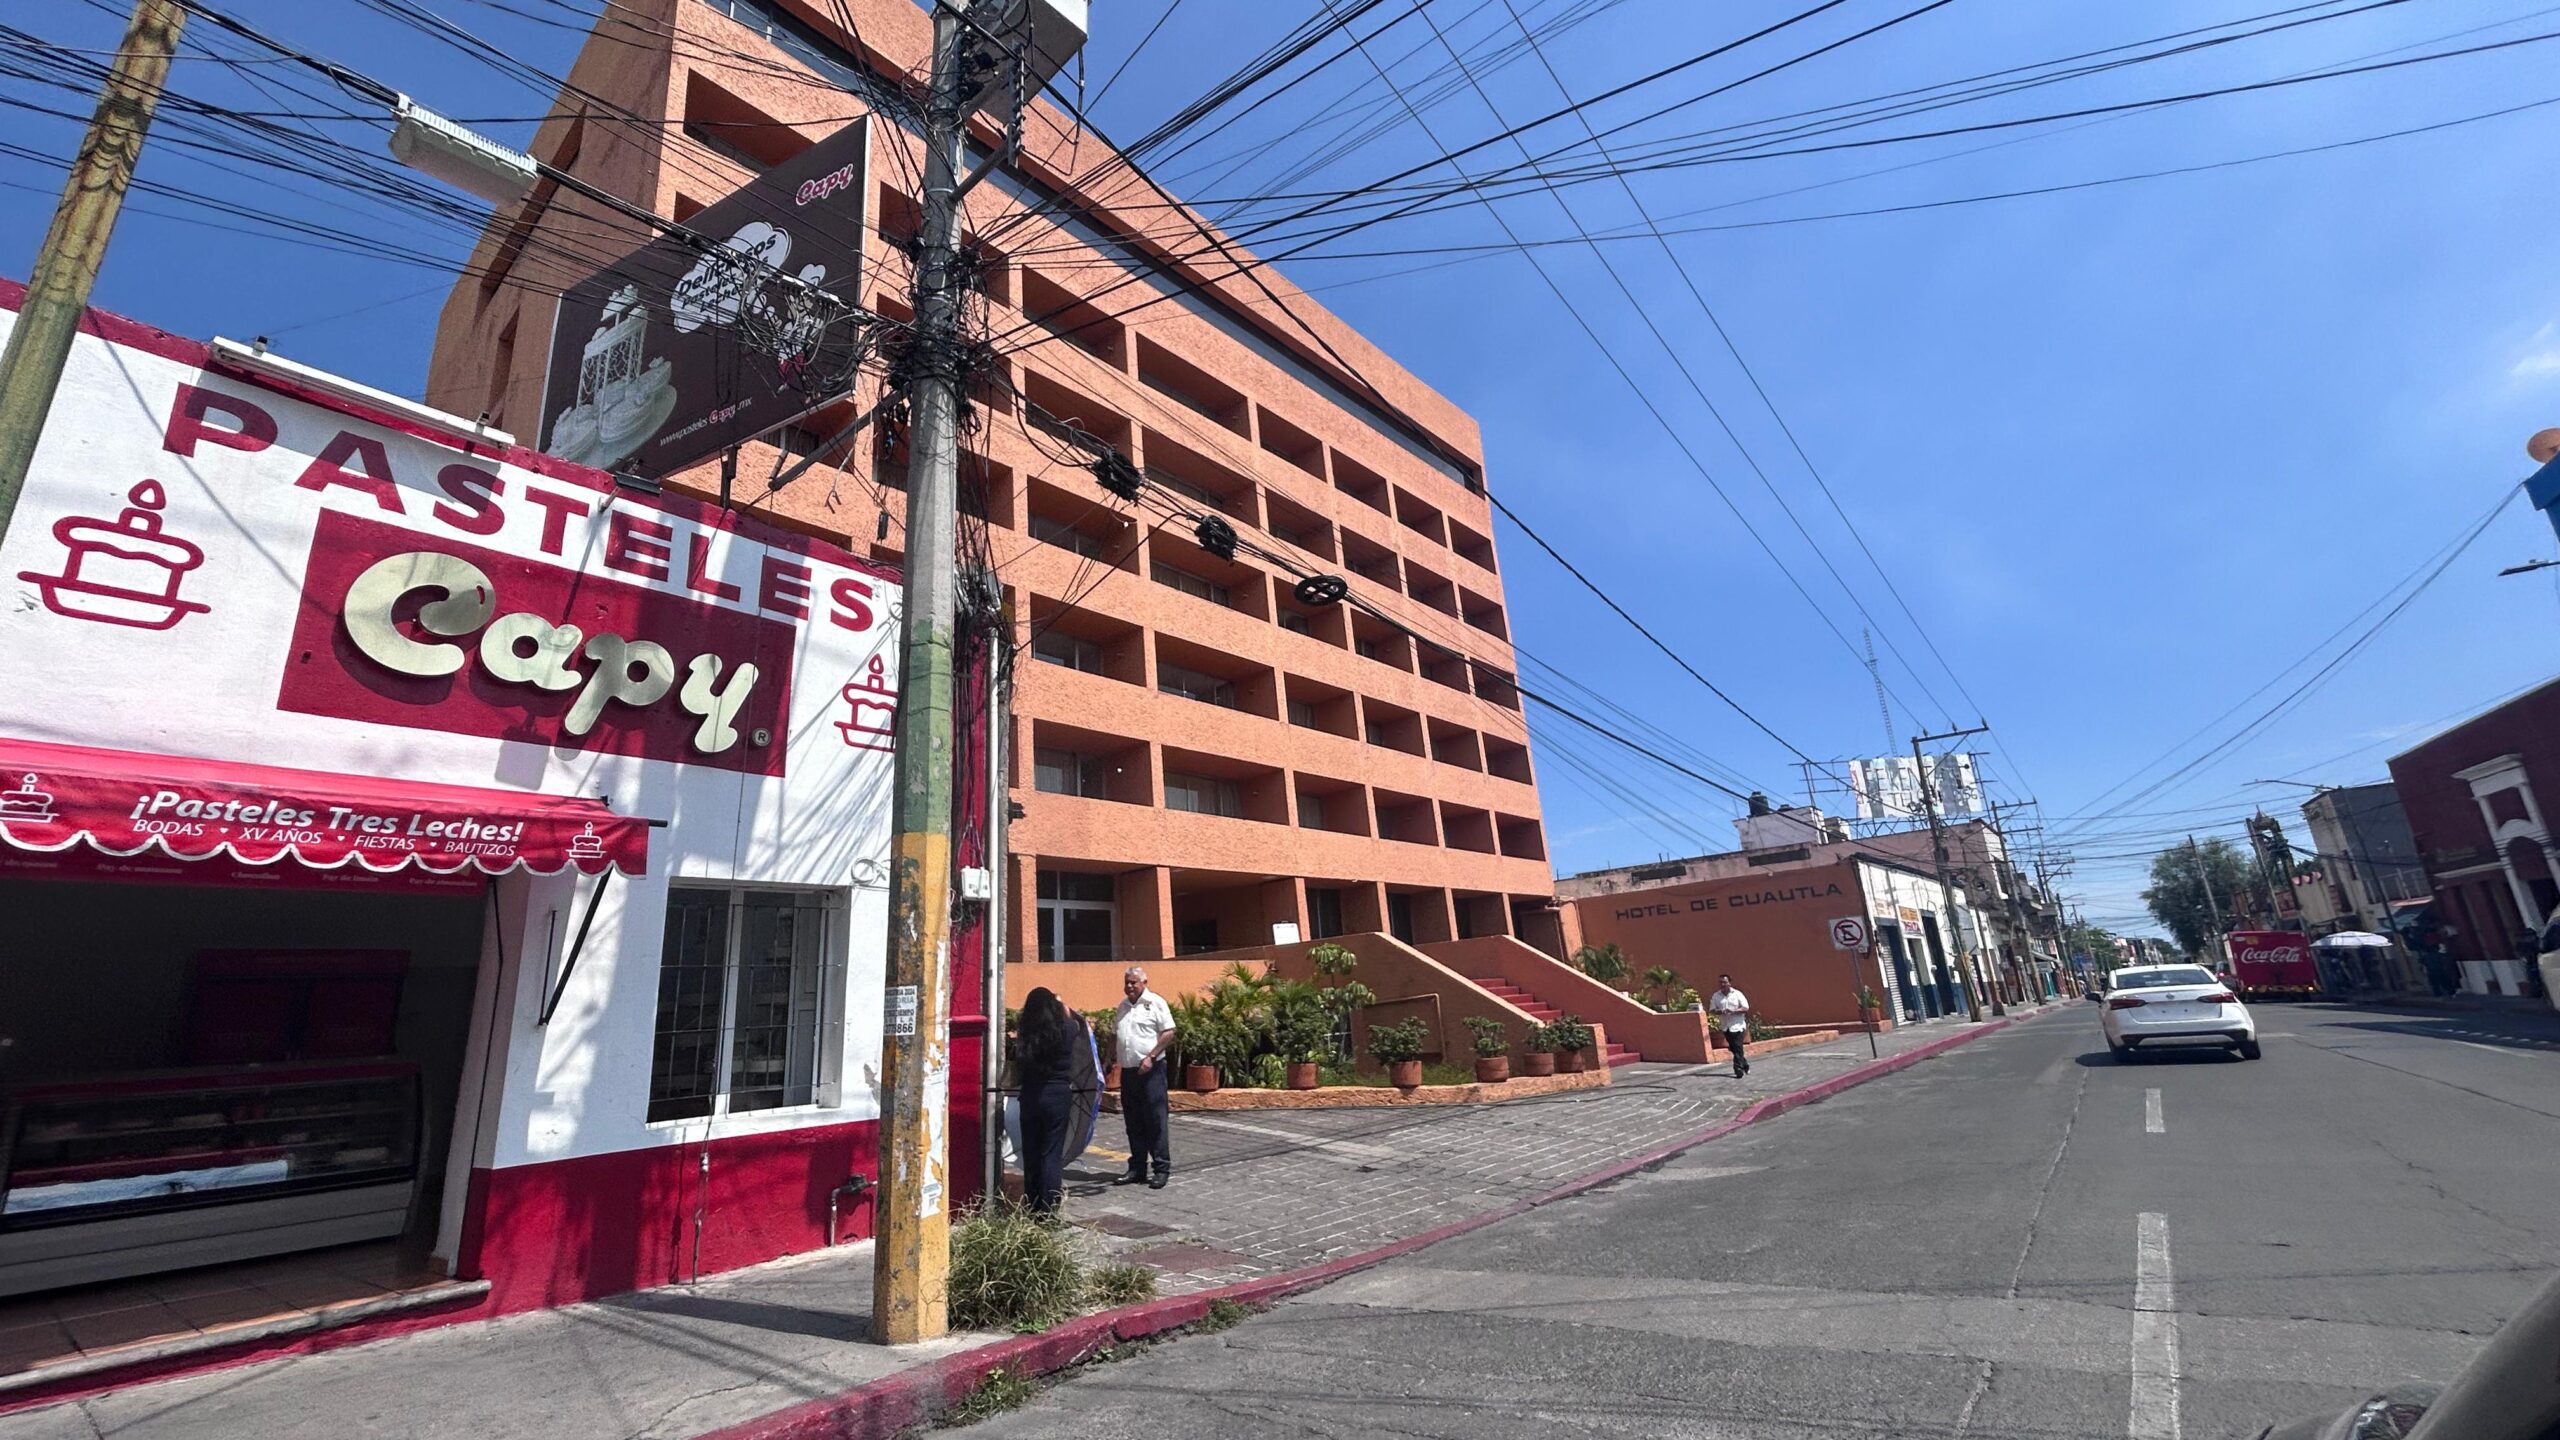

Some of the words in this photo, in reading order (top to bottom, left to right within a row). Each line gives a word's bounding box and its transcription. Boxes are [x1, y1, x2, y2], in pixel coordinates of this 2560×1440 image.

[796, 163, 854, 206] Capy
[162, 381, 874, 632] PASTELES
[344, 551, 760, 753] Capy
[129, 790, 316, 827] ¡Pasteles
[328, 806, 399, 834] Tres
[406, 814, 525, 842] Leches!
[132, 819, 206, 836] BODAS
[238, 827, 268, 840] XV
[270, 827, 324, 844] AÑOS
[353, 835, 416, 850] FIESTAS
[444, 841, 517, 857] BAUTIZOS
[1615, 903, 1680, 921] HOTEL
[1690, 898, 1719, 912] DE
[1728, 883, 1843, 909] CUAUTLA
[2241, 946, 2302, 964] Coca-Cola
